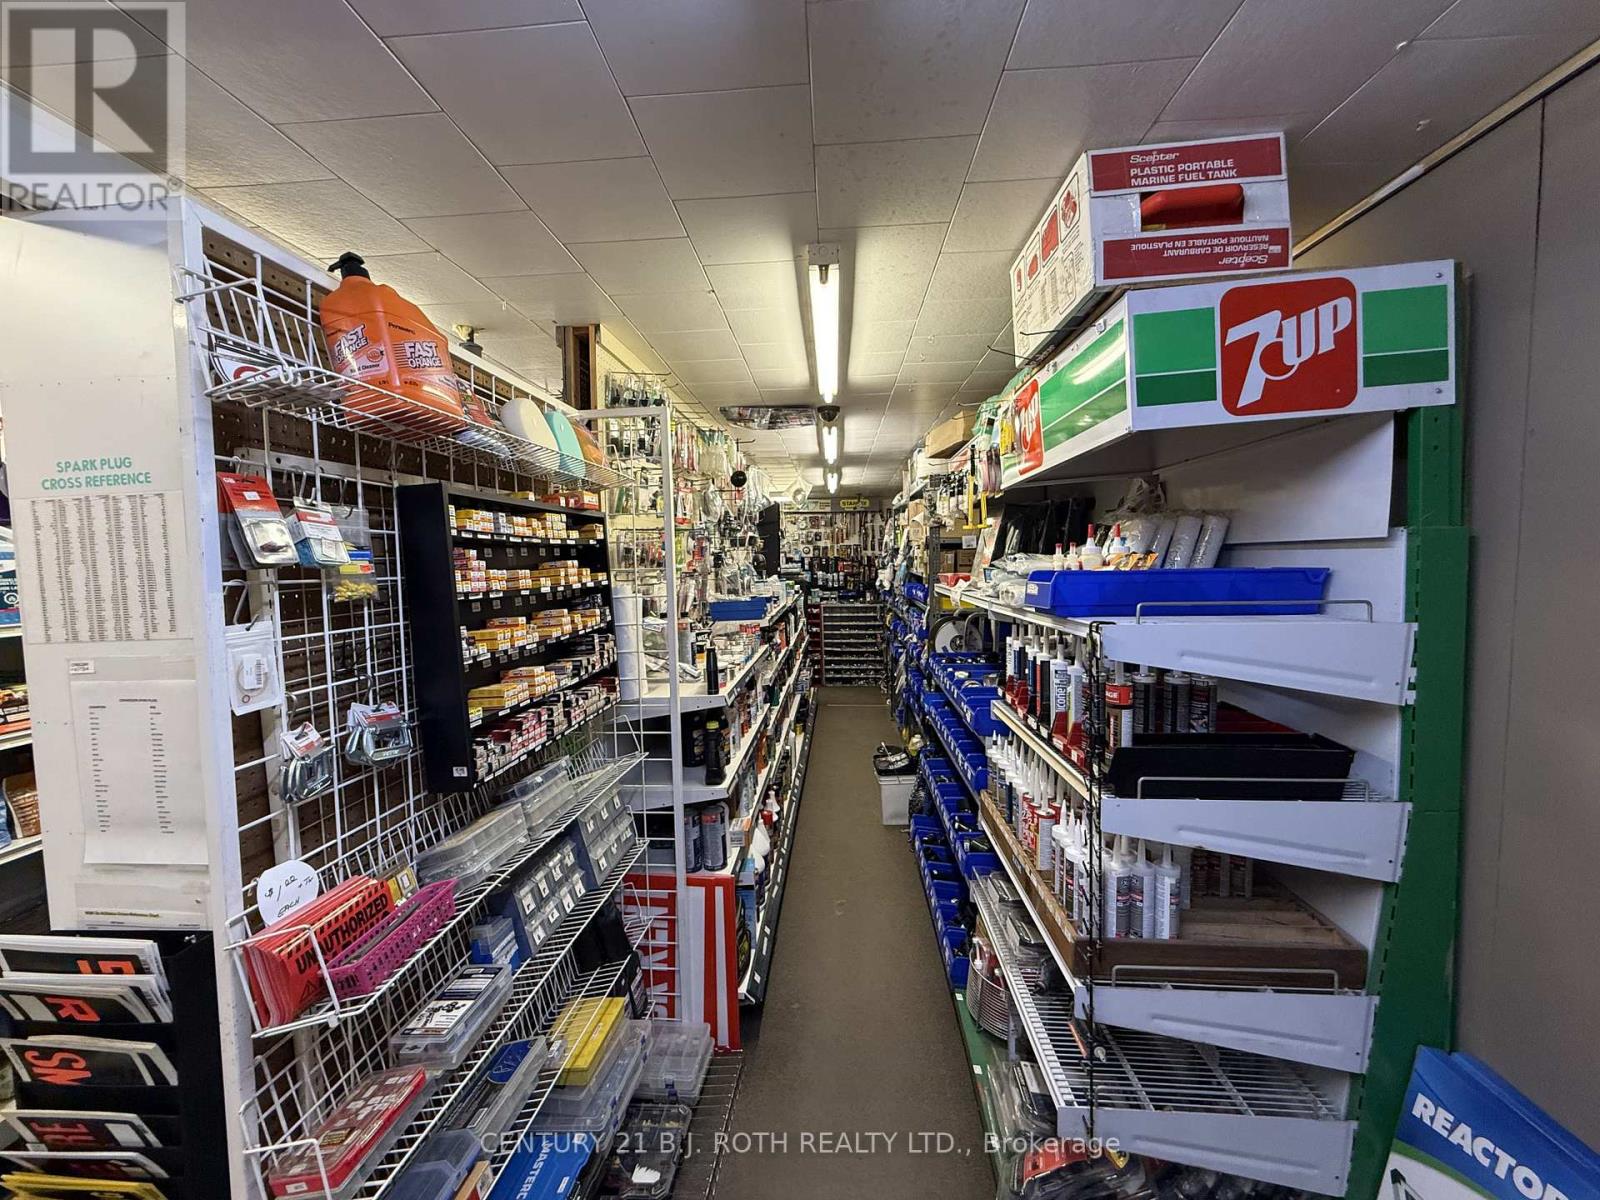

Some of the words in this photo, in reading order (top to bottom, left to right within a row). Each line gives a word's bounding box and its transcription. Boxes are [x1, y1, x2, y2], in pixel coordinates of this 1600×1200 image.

[1130, 151, 1180, 165] Scepter
[1130, 164, 1175, 176] PLASTIC
[1177, 158, 1235, 172] PORTABLE
[1131, 175, 1176, 187] MARINE
[1178, 172, 1205, 182] FUEL
[1206, 168, 1238, 180] TANK
[1130, 240, 1174, 251] PLASTIQUE
[1174, 239, 1187, 249] EN
[1187, 236, 1228, 247] PORTABLE
[1229, 234, 1269, 245] NAUTIQUE
[1163, 246, 1211, 257] CARBURANT
[1218, 254, 1269, 267] Scepter
[334, 324, 366, 356] FAST
[403, 341, 439, 358] FAST
[408, 356, 444, 369] ORANGE
[56, 458, 97, 473] SPARK
[99, 456, 132, 471] PLUG
[41, 477, 82, 490] CROSS
[85, 471, 152, 488] REFERENCE
[295, 893, 389, 974] UNAUTHORIZED
